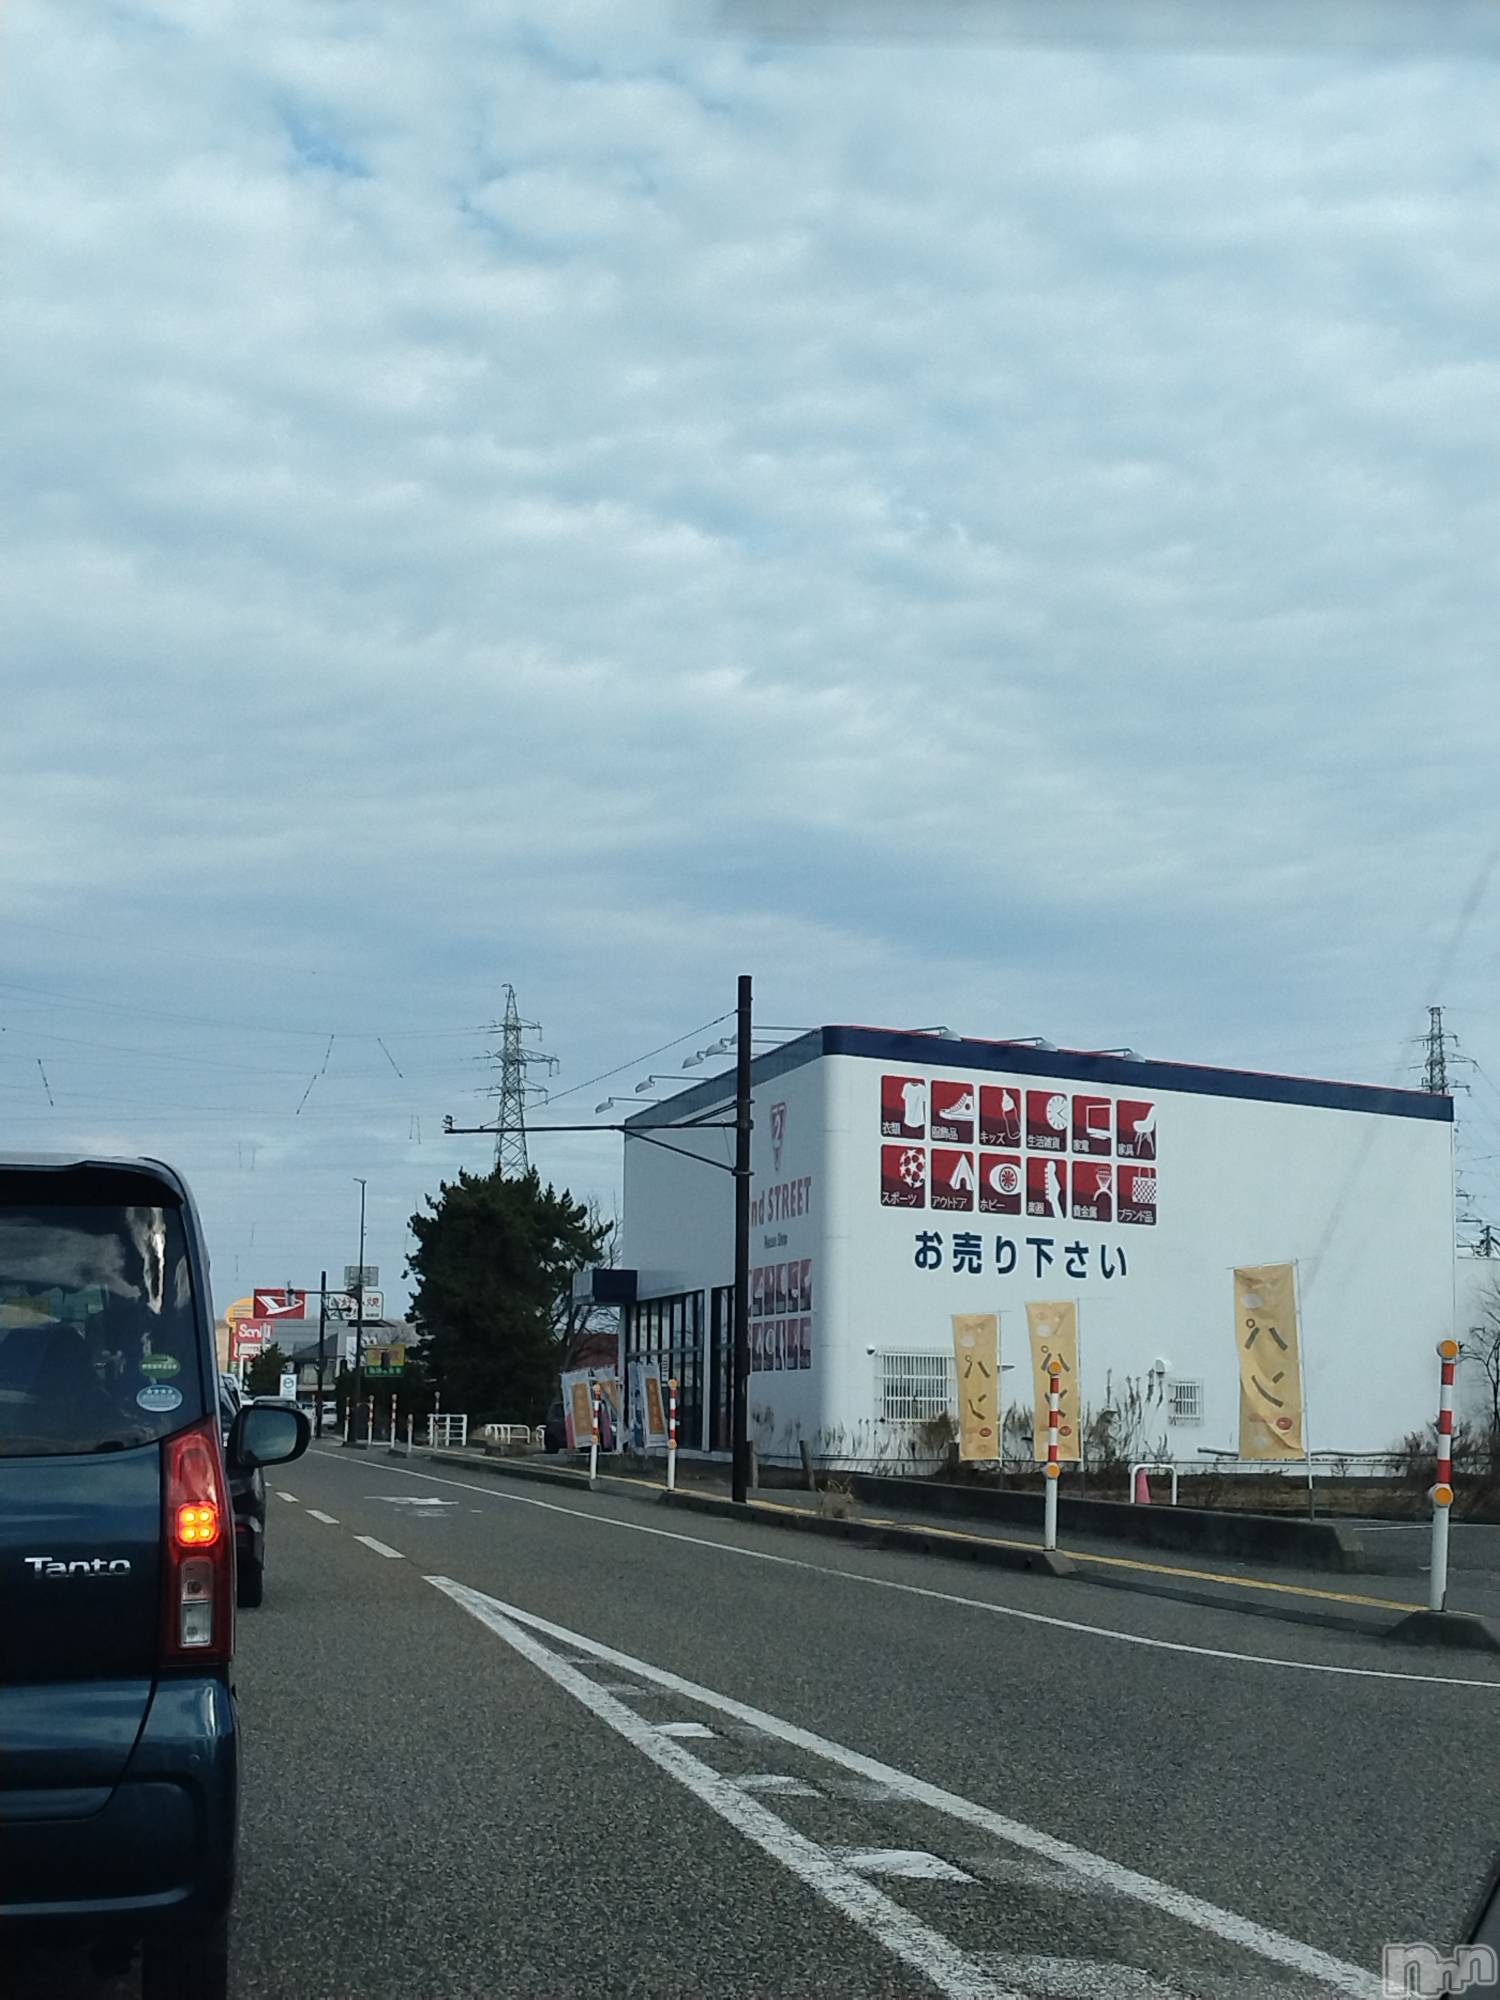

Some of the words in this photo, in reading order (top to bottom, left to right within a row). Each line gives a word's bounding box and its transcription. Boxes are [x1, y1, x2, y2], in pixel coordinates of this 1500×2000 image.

[882, 1121, 901, 1135] 衣類
[980, 1132, 1005, 1144] キッズ
[1027, 1135, 1060, 1149] 生活雑貨
[1073, 1139, 1089, 1152] 家電
[1118, 1143, 1134, 1156] 家具
[767, 1176, 812, 1222] STREET
[882, 1191, 917, 1205] スポーツ
[931, 1195, 967, 1209] アウトドア
[980, 1199, 1005, 1210] ホビー
[1073, 1205, 1097, 1218] 貴金属
[1118, 1208, 1153, 1223] ブランド品
[914, 1230, 1128, 1280] お売り下さい
[24, 1556, 131, 1577] Tanto
